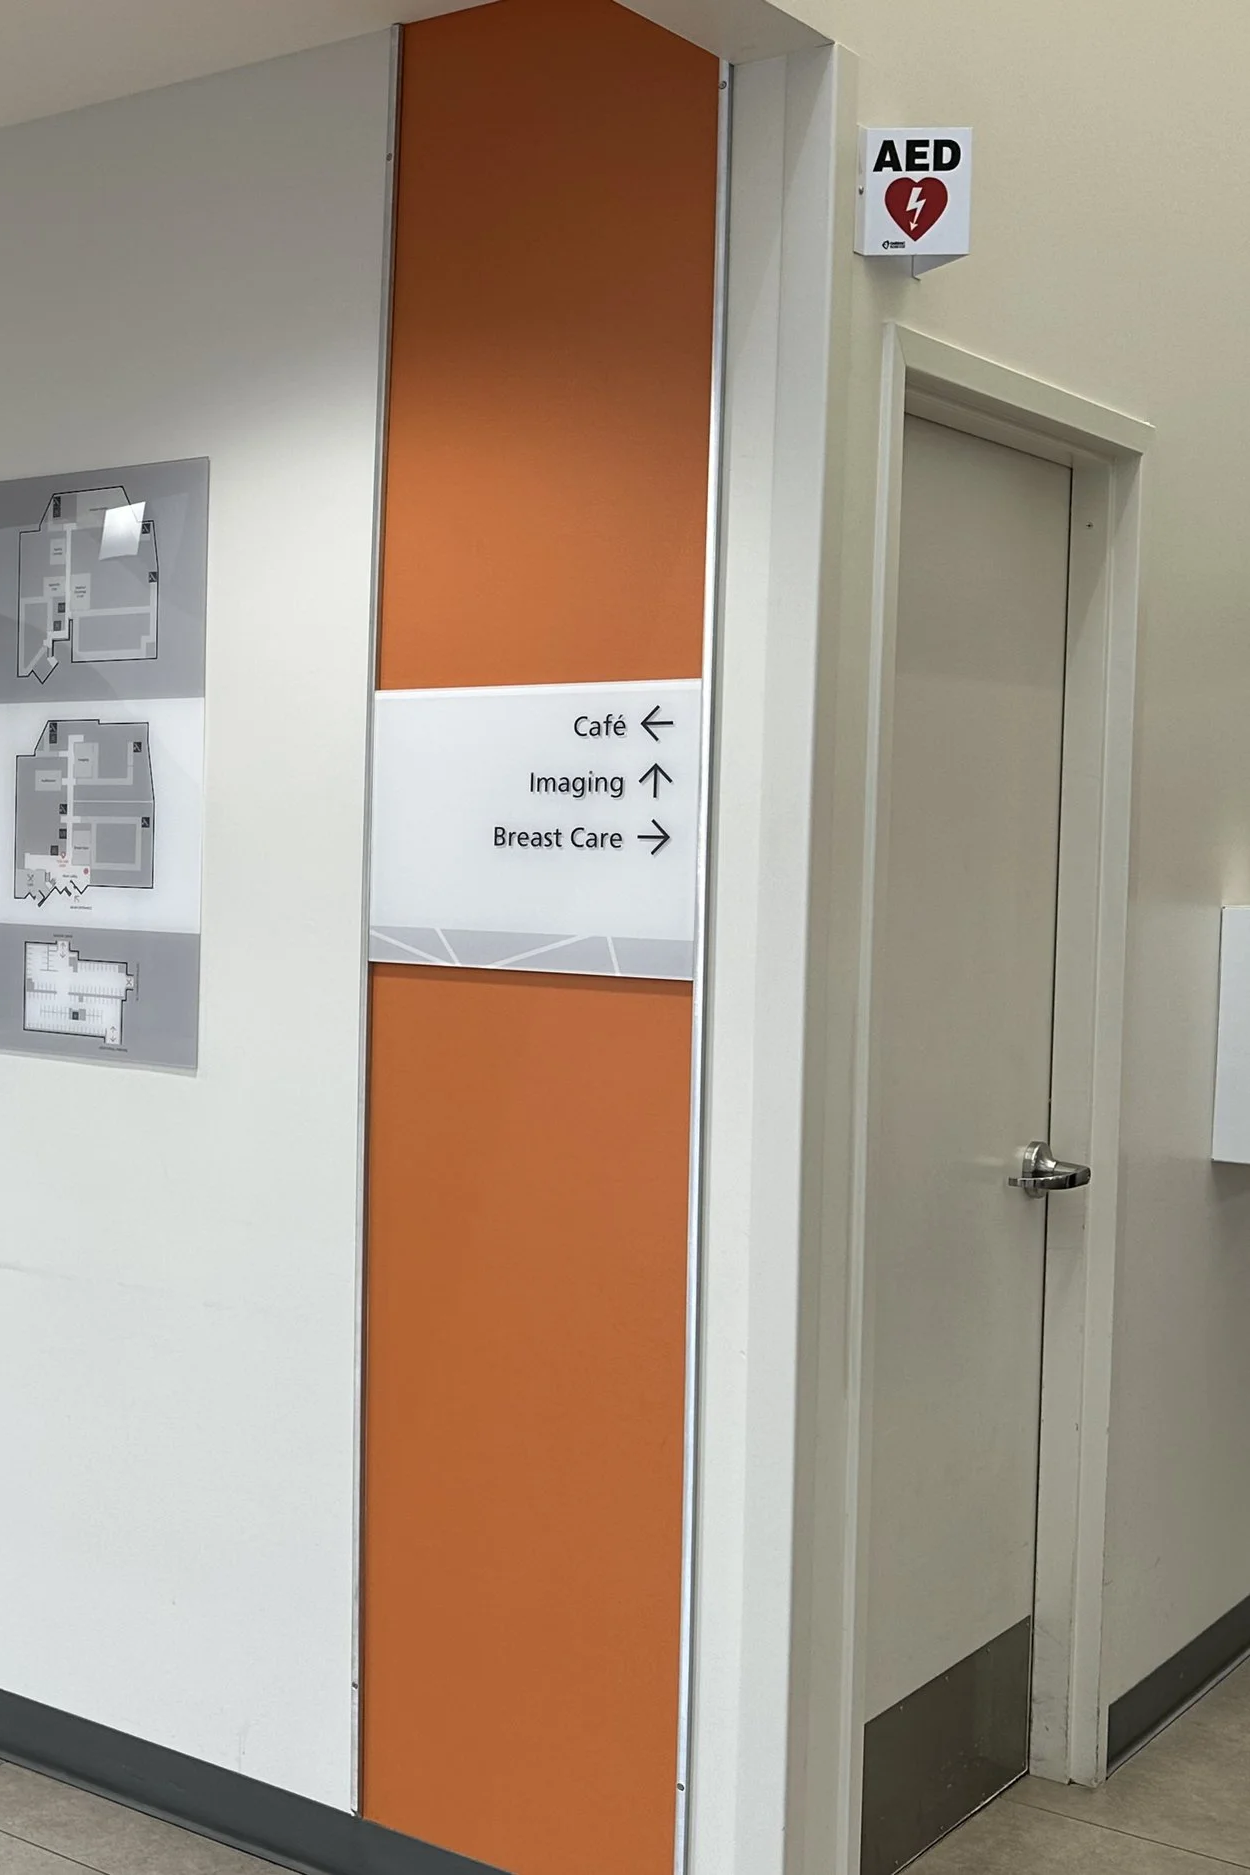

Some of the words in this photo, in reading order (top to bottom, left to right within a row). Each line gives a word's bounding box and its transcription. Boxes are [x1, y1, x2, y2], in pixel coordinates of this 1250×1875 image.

[873, 139, 961, 173] AED
[573, 713, 628, 738] Café
[529, 771, 625, 798] Imaging
[493, 826, 563, 849] Breast
[570, 826, 624, 849] Care
